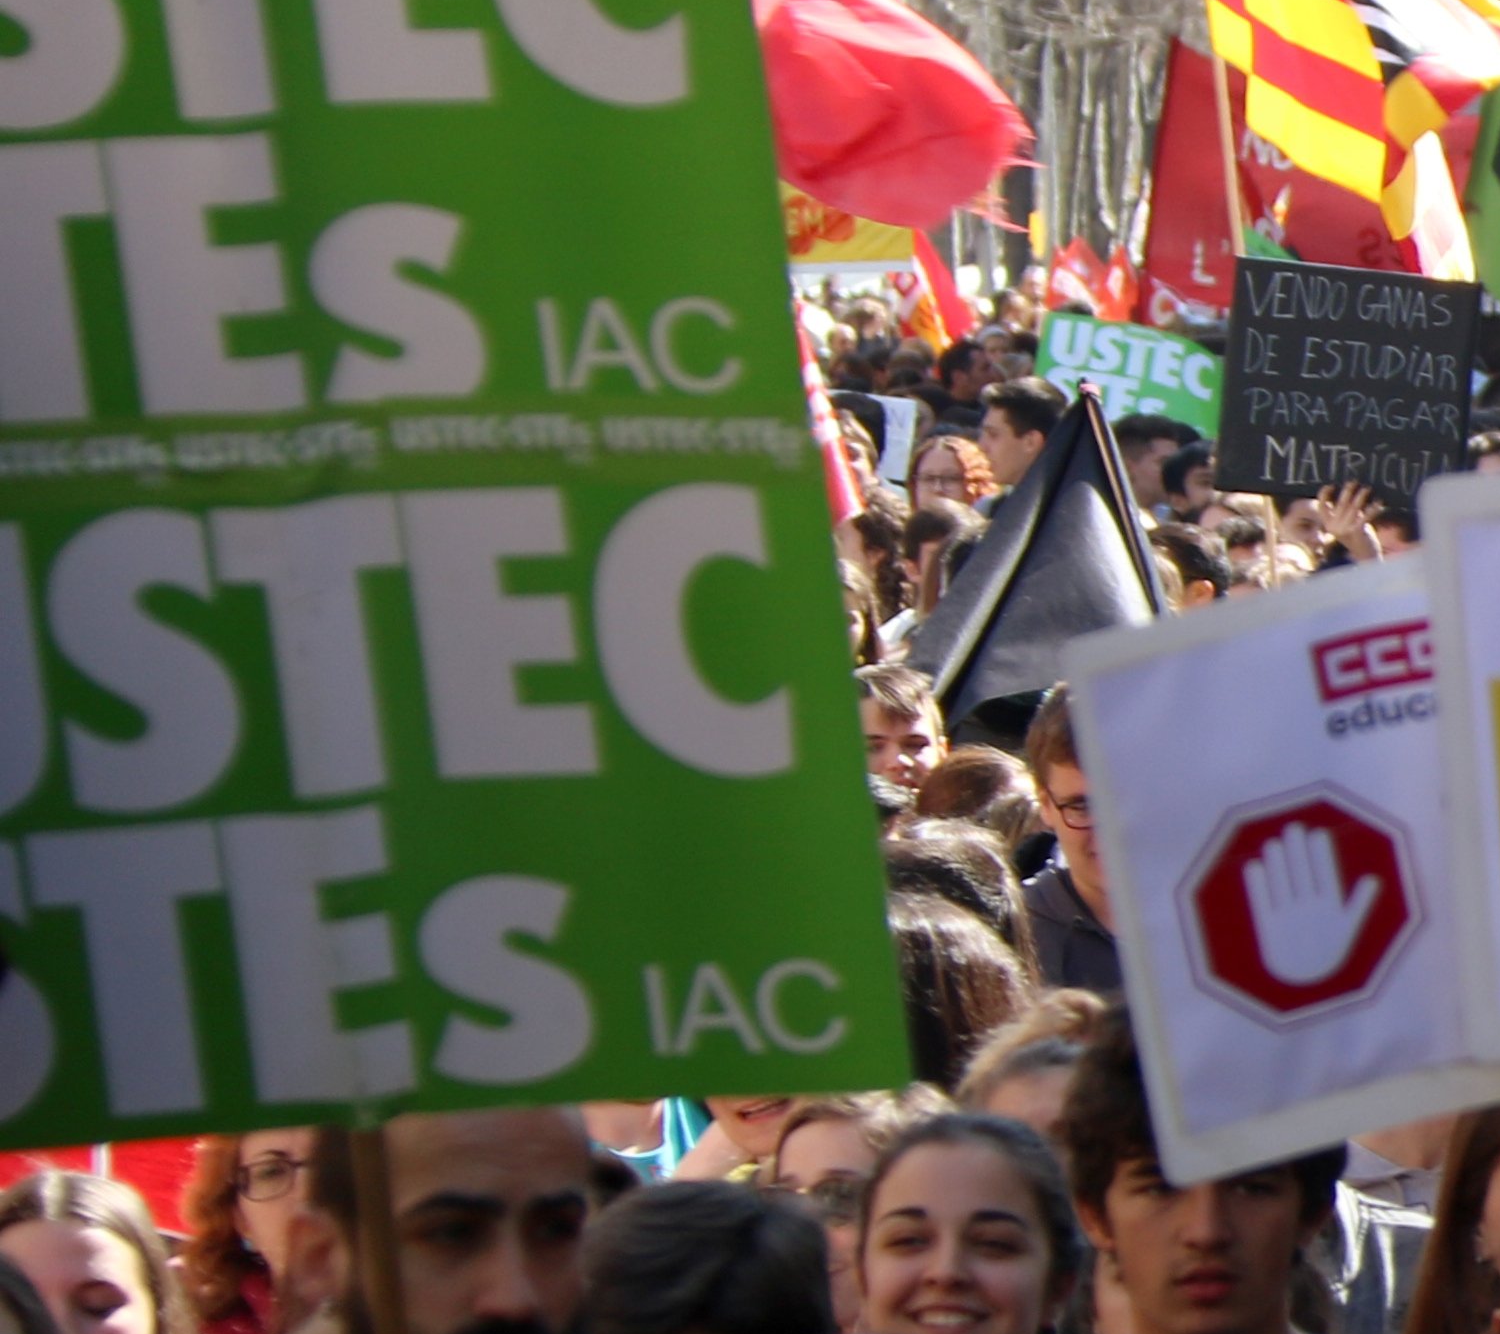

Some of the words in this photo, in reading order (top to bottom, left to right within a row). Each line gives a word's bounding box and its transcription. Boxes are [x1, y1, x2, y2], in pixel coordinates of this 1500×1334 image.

[1244, 269, 1350, 322] VENDO
[1356, 283, 1453, 329] GANAS
[537, 297, 744, 394] IAC
[1049, 318, 1216, 403] USTEC
[1242, 326, 1280, 375] DE
[1242, 386, 1331, 427] PARA
[1333, 391, 1461, 442] PAGAR
[0, 482, 796, 817] STEC
[645, 958, 846, 1053] IAC
